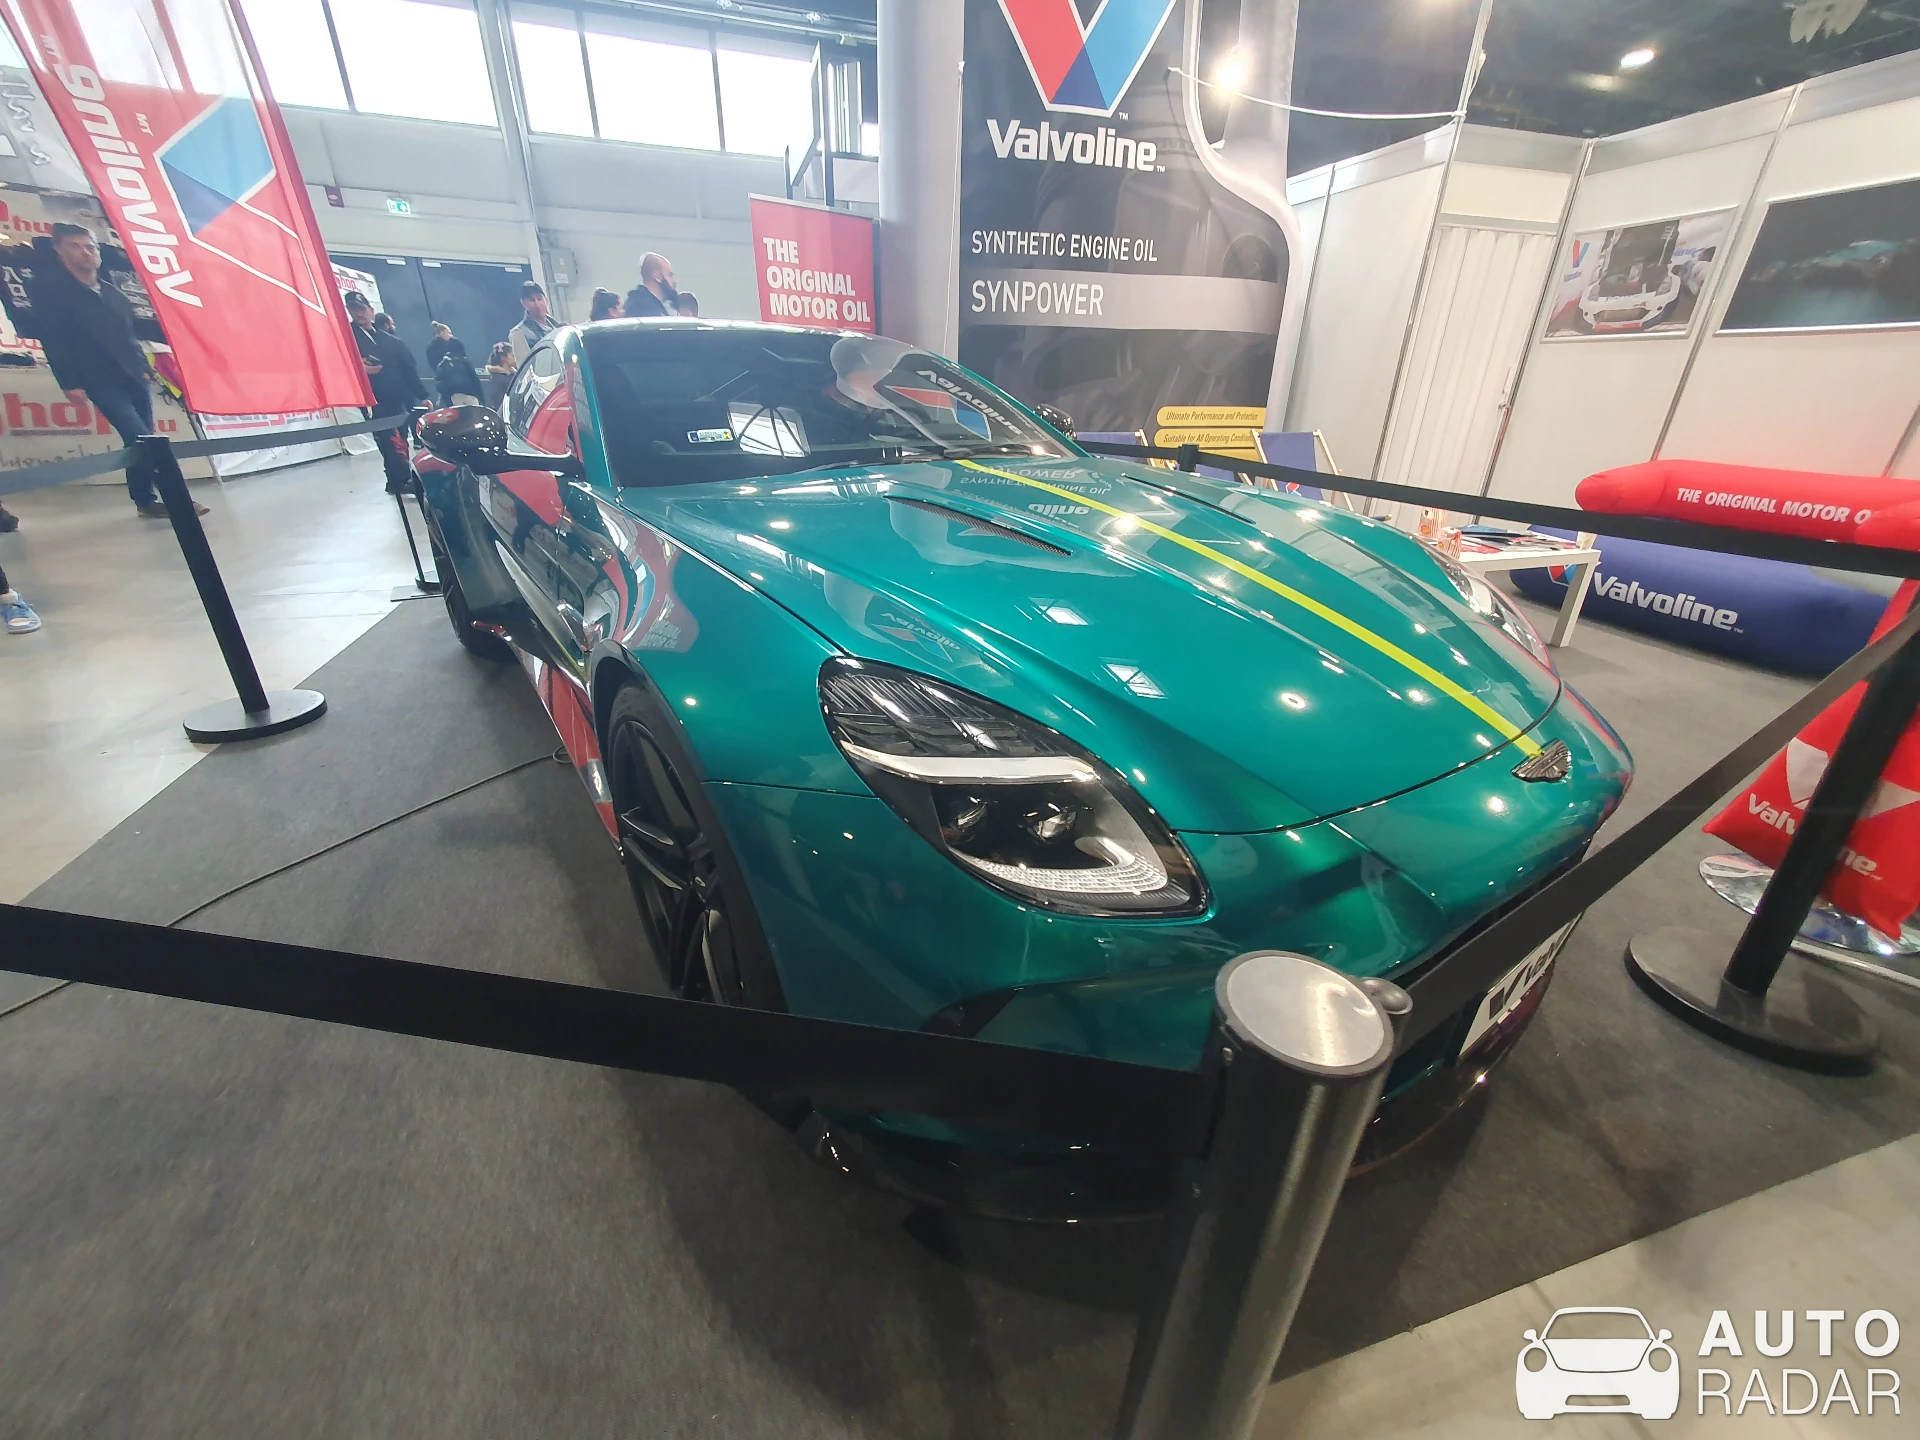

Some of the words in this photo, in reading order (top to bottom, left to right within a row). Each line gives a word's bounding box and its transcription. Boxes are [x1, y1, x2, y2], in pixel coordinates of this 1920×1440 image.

[986, 119, 1157, 172] Valvoline
[762, 236, 799, 264] THE
[971, 230, 1066, 257] SYNTHETIC
[1070, 234, 1131, 261] ENGINE
[1133, 238, 1158, 262] OIL
[766, 265, 856, 297] ORIGINAL
[769, 293, 839, 321] MOTOR
[842, 299, 871, 323] OIL
[971, 279, 1104, 316] SYNPOWER
[1166, 411, 1190, 420] Ultimate
[1190, 411, 1224, 421] Performance
[1224, 411, 1235, 420] and
[1235, 411, 1259, 421] Protection
[1163, 433, 1187, 443] Suitable
[1187, 433, 1196, 443] for
[1196, 433, 1204, 442] All
[1204, 433, 1230, 444] Operating
[1676, 487, 1702, 504] THE
[1704, 491, 1777, 514] ORIGINAL
[1781, 500, 1850, 523] MOTOR
[1594, 572, 1739, 631] Valvoline
